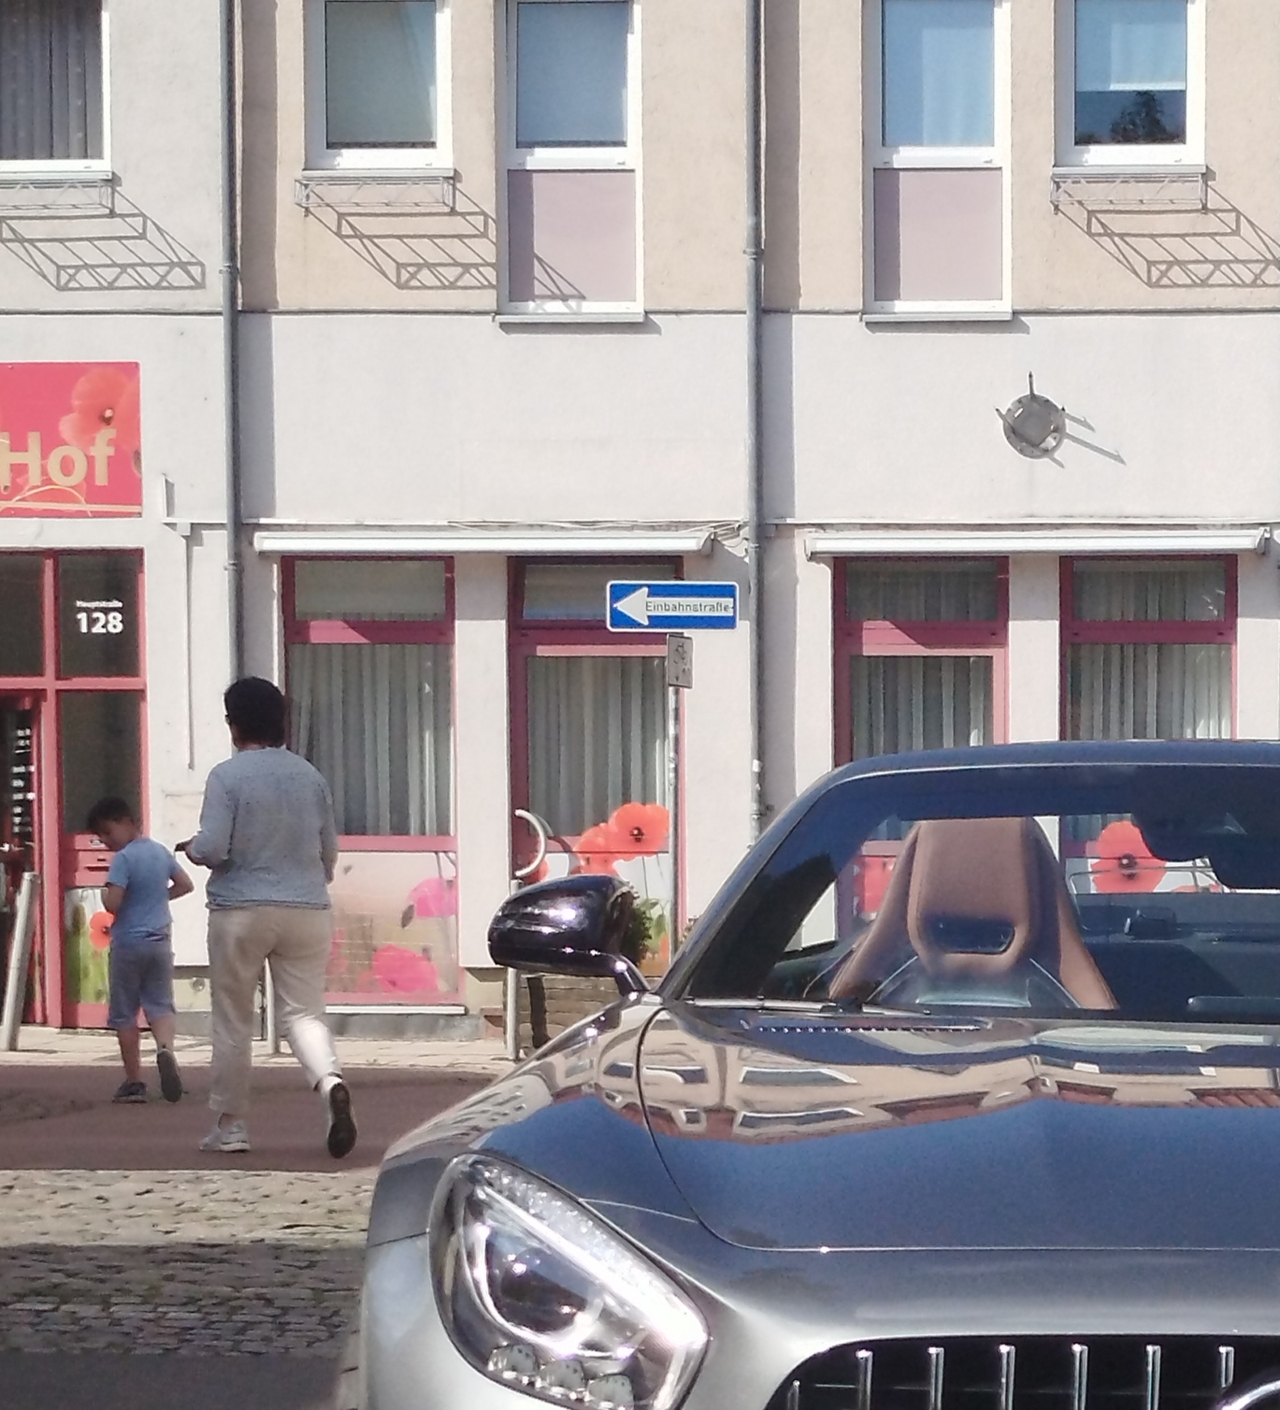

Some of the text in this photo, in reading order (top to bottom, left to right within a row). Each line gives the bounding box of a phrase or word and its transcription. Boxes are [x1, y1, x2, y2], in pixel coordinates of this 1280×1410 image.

[0, 428, 117, 487] Hof
[645, 601, 730, 612] Einbahnstraße
[76, 611, 123, 633] 128
